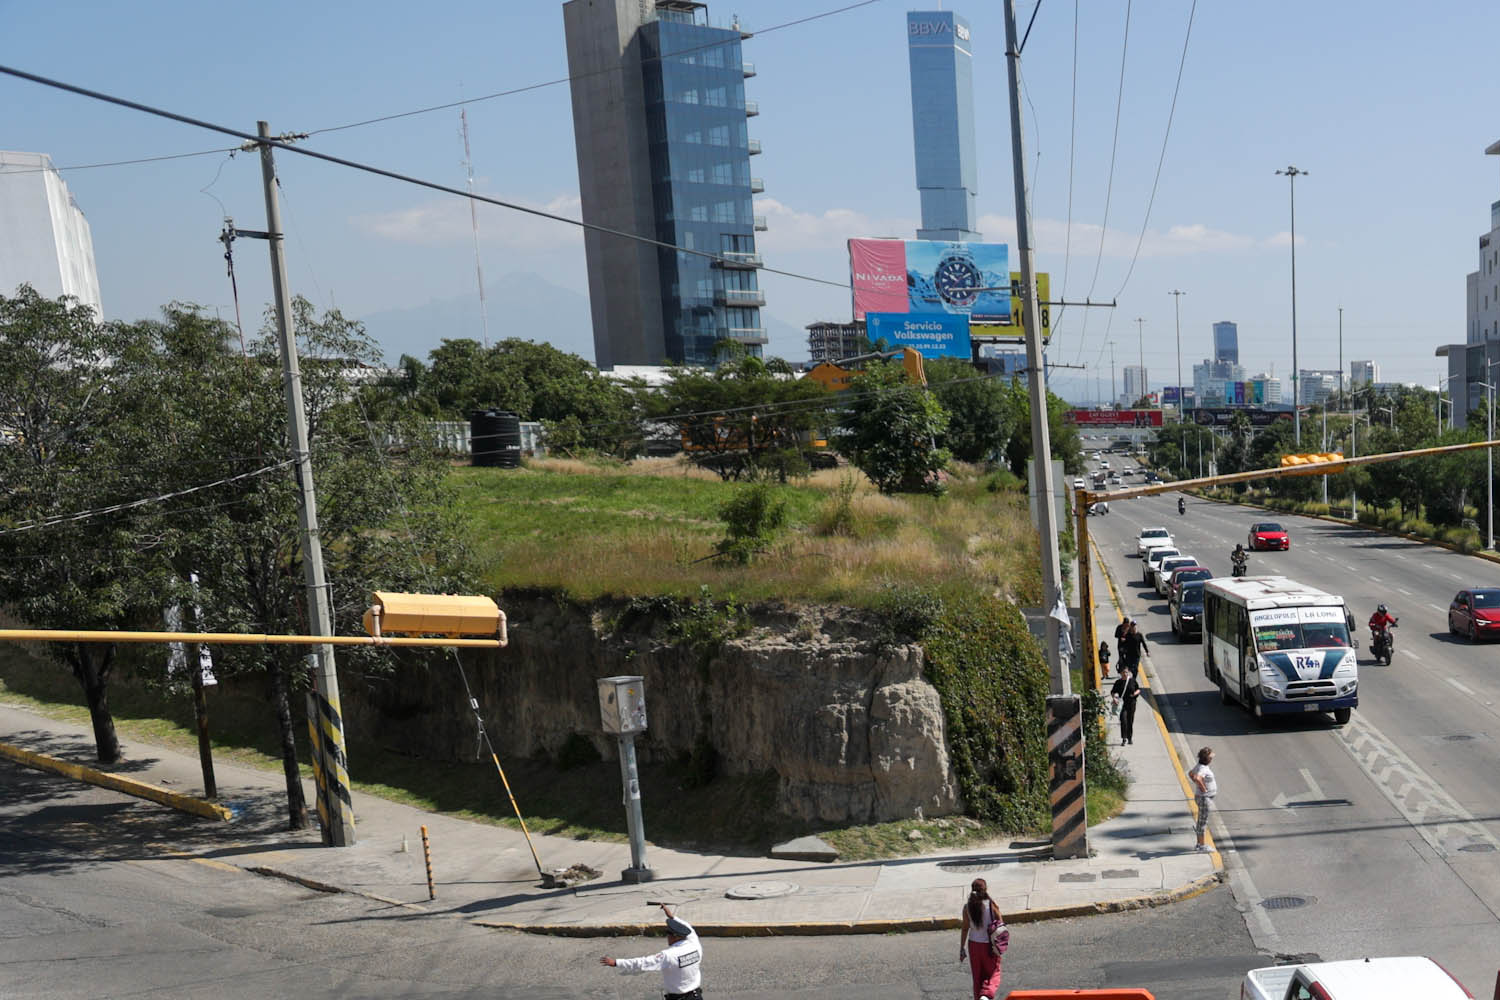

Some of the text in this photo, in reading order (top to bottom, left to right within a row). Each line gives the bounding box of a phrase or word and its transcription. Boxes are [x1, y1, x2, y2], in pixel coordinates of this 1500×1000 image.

[910, 22, 952, 34] BBVA
[855, 272, 905, 282] NIVADA
[903, 321, 943, 331] Servicio
[894, 330, 954, 342] Volkswagen
